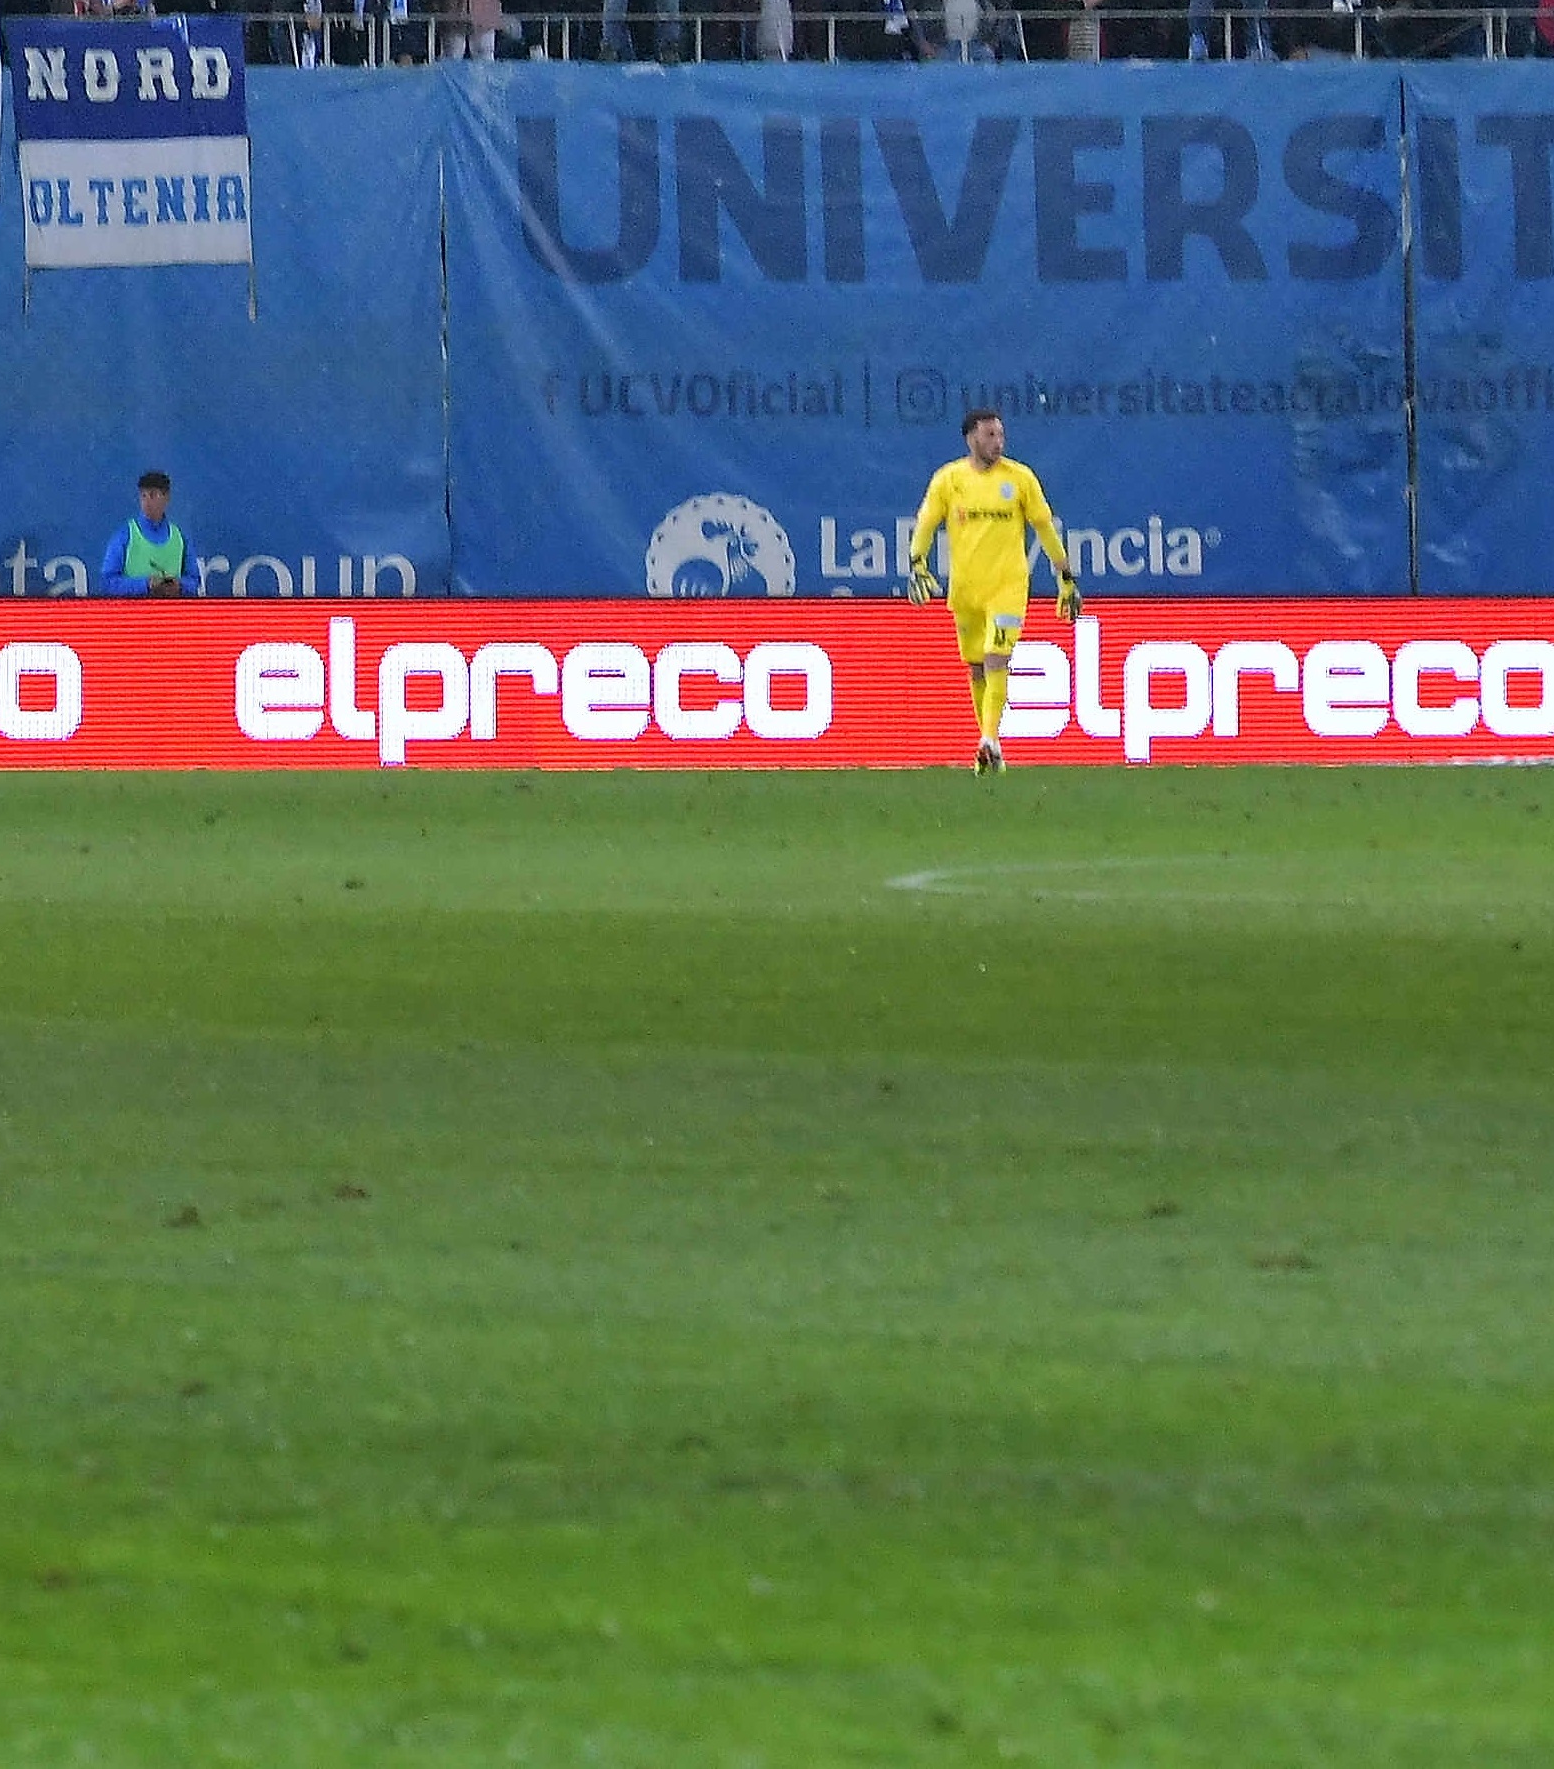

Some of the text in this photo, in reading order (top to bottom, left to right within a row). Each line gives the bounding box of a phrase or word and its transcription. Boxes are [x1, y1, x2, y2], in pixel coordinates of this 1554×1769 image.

[25, 44, 233, 105] NORD
[29, 173, 247, 226] OLTENIA
[192, 553, 417, 598] roup
[234, 615, 833, 768] elpreco
